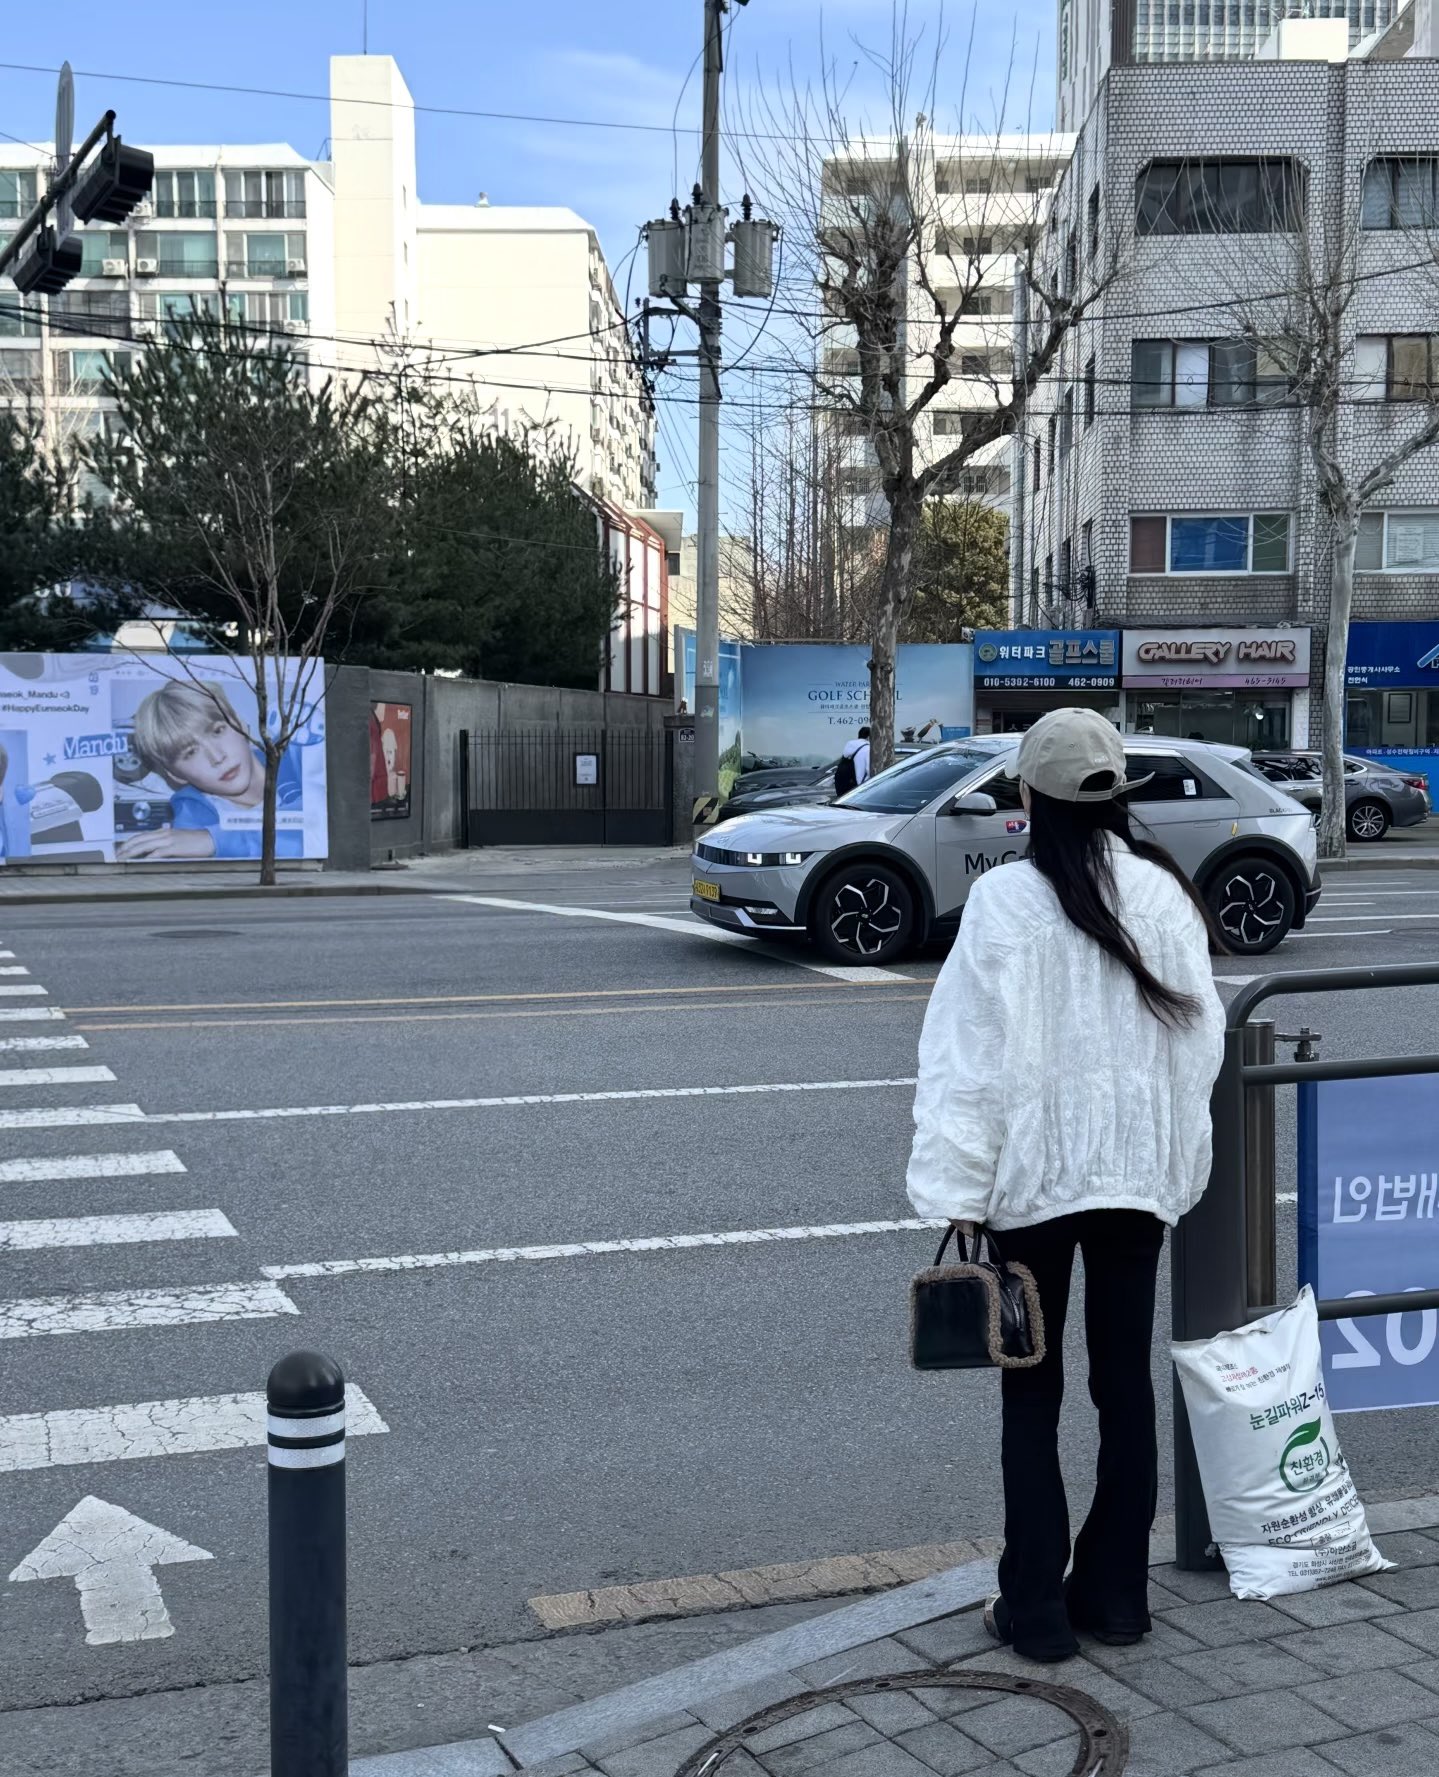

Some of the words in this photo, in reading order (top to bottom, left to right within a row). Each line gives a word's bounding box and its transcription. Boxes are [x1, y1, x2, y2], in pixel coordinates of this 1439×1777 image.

[1000, 646, 1046, 659] 워터파크
[1049, 640, 1114, 664] 골프스쿨
[1138, 642, 1232, 664] GALLERY
[1238, 641, 1296, 662] HAIR
[1069, 677, 1115, 687] 462-0909
[808, 690, 843, 701] GOLF
[847, 690, 903, 701] SCHL
[65, 735, 128, 759] Mandu
[1290, 1449, 1324, 1476] 친환경
[1261, 1509, 1307, 1534] 자원순환성
[1292, 1561, 1309, 1569] 경기도
